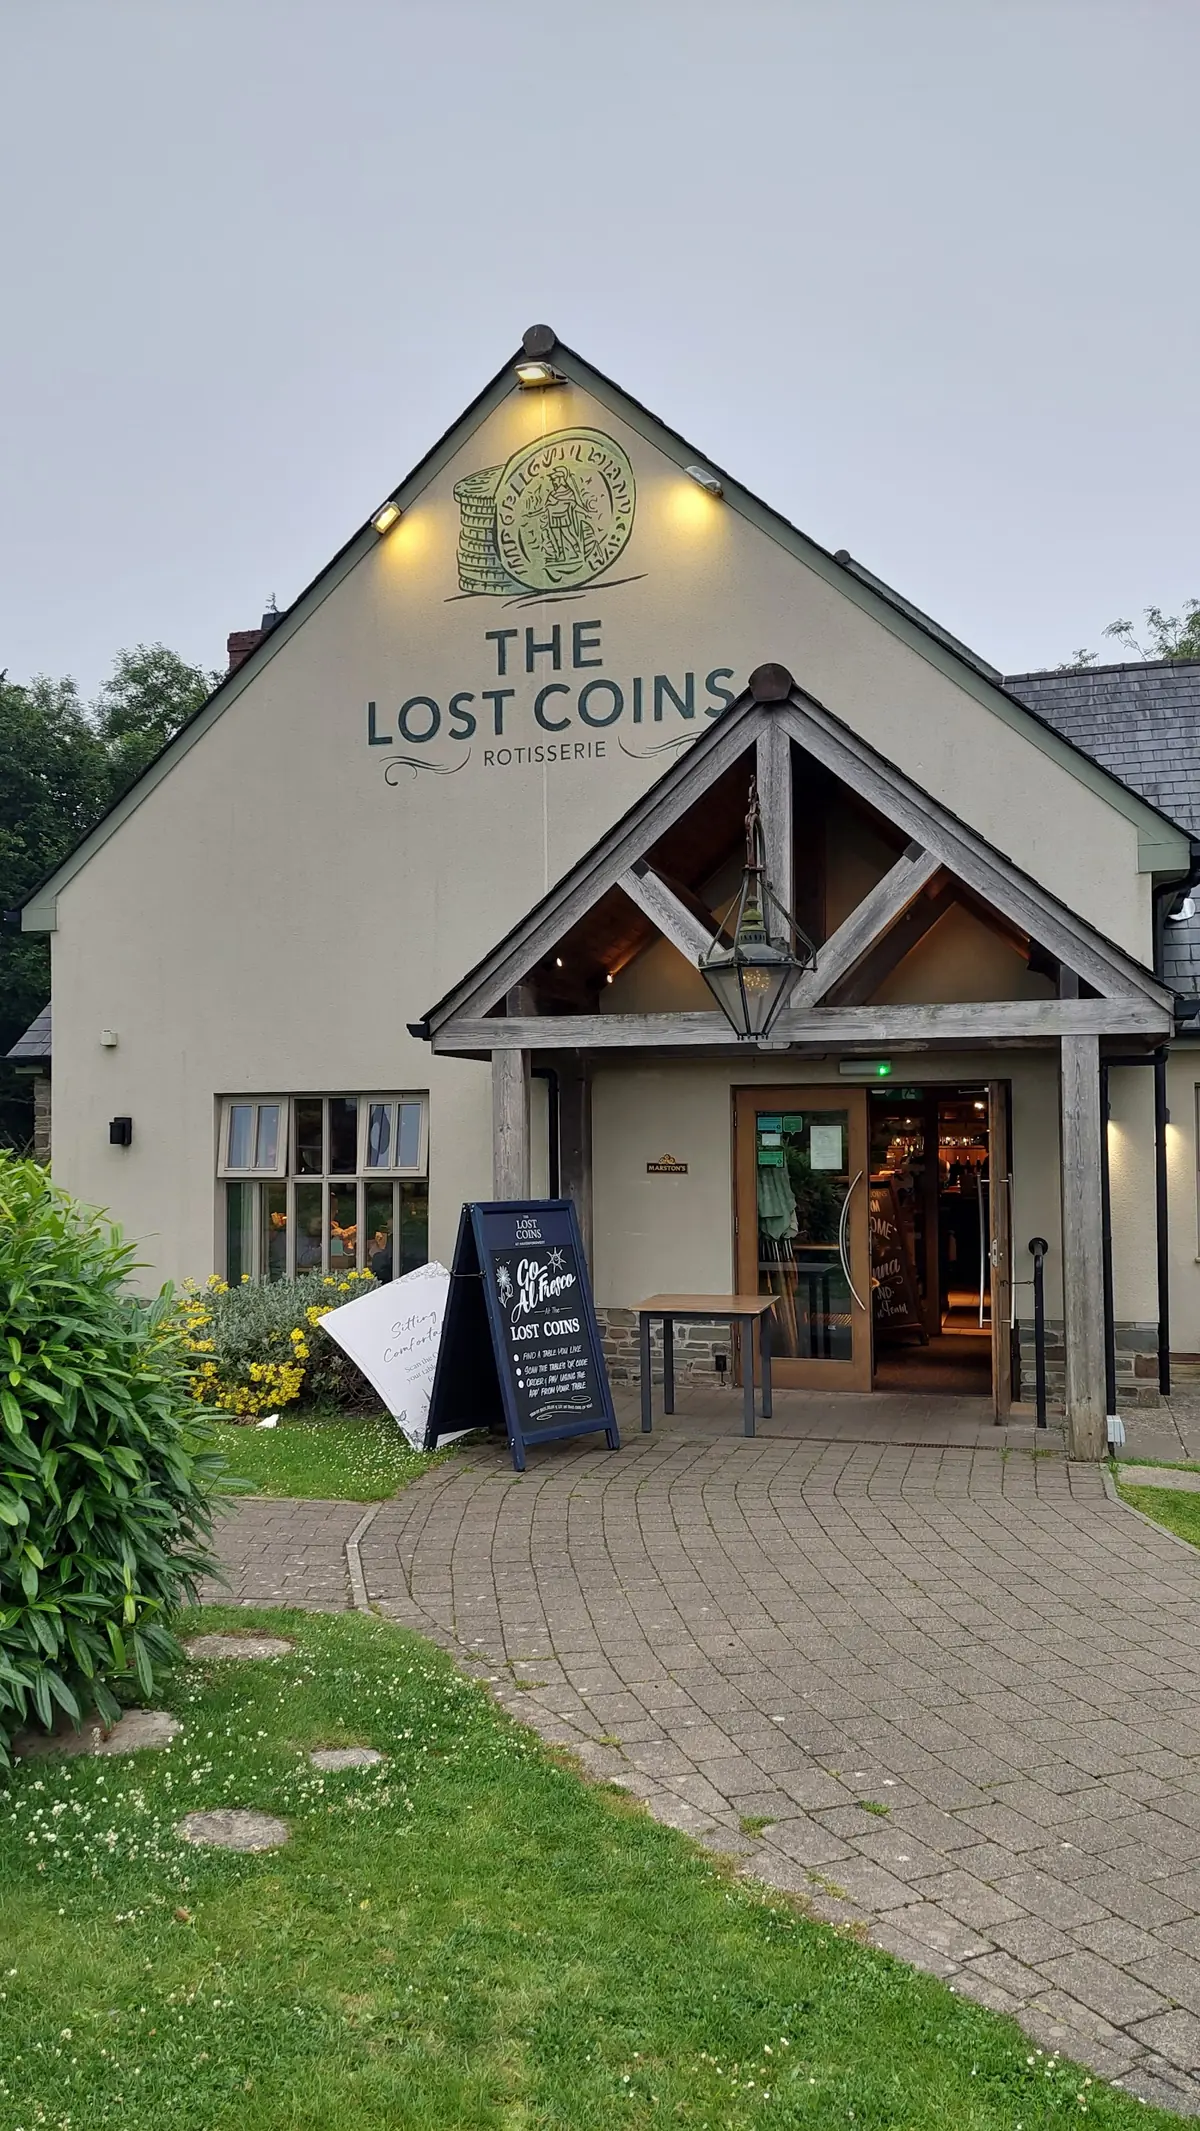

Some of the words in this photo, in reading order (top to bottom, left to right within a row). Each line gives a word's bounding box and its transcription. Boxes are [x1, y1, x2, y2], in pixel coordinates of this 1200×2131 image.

[486, 620, 603, 675] THE
[368, 688, 515, 745] LOST
[534, 668, 735, 732] COINS
[484, 741, 606, 766] ROTISSERIE
[515, 1229, 542, 1239] COINS
[516, 1219, 538, 1229] LOST
[517, 1258, 548, 1291] Go
[511, 1281, 538, 1323] Al
[538, 1272, 576, 1302] Fresco
[391, 1311, 437, 1339] Sitting
[510, 1324, 540, 1341] LOST
[543, 1318, 580, 1336] COINS
[384, 1326, 442, 1363] Comforta
[522, 1351, 536, 1360] FIND
[537, 1350, 541, 1358] A
[542, 1349, 557, 1358] TABLE
[557, 1346, 568, 1355] YOU
[569, 1345, 582, 1353] LIKE
[404, 1361, 422, 1374] Scan
[421, 1355, 434, 1366] the
[524, 1365, 538, 1375] SCAN
[538, 1364, 548, 1372] THE
[575, 1358, 588, 1367] CODE
[526, 1377, 544, 1387] ORDER
[540, 1386, 555, 1396] FROM
[571, 1382, 587, 1391] TABLE
